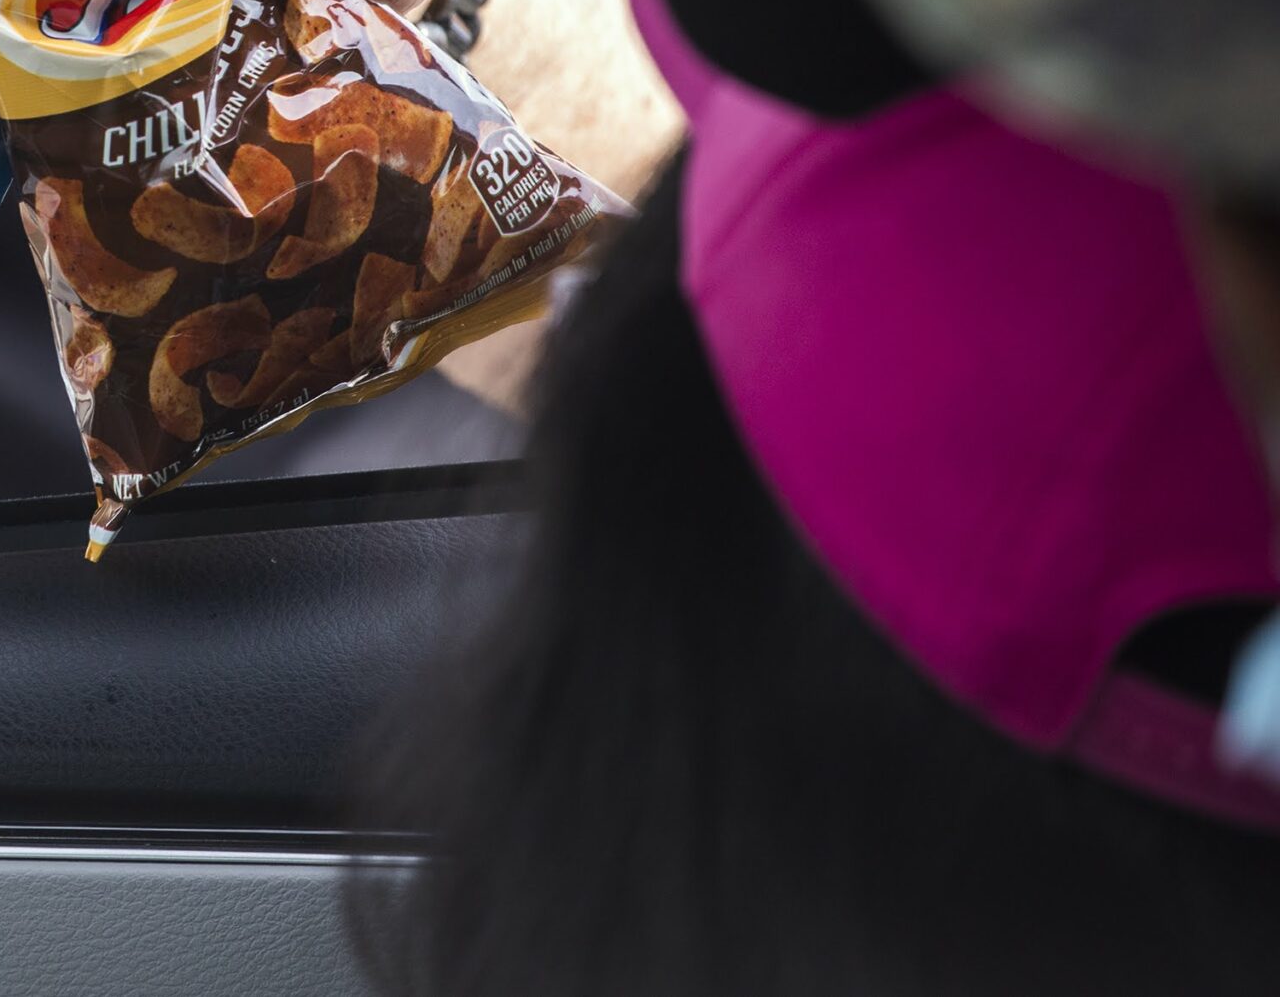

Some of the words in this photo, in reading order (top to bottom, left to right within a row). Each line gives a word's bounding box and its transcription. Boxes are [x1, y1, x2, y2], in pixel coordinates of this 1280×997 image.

[209, 90, 247, 138] CORN
[238, 41, 278, 90] CHIPS
[476, 132, 532, 196] 320
[494, 162, 548, 217] CALORIES
[505, 206, 532, 229] PER
[531, 179, 556, 209] PKG
[511, 253, 527, 273] for
[528, 233, 555, 260] Total
[556, 222, 572, 244] Fat
[113, 473, 144, 500] NET
[148, 461, 181, 488] WT
